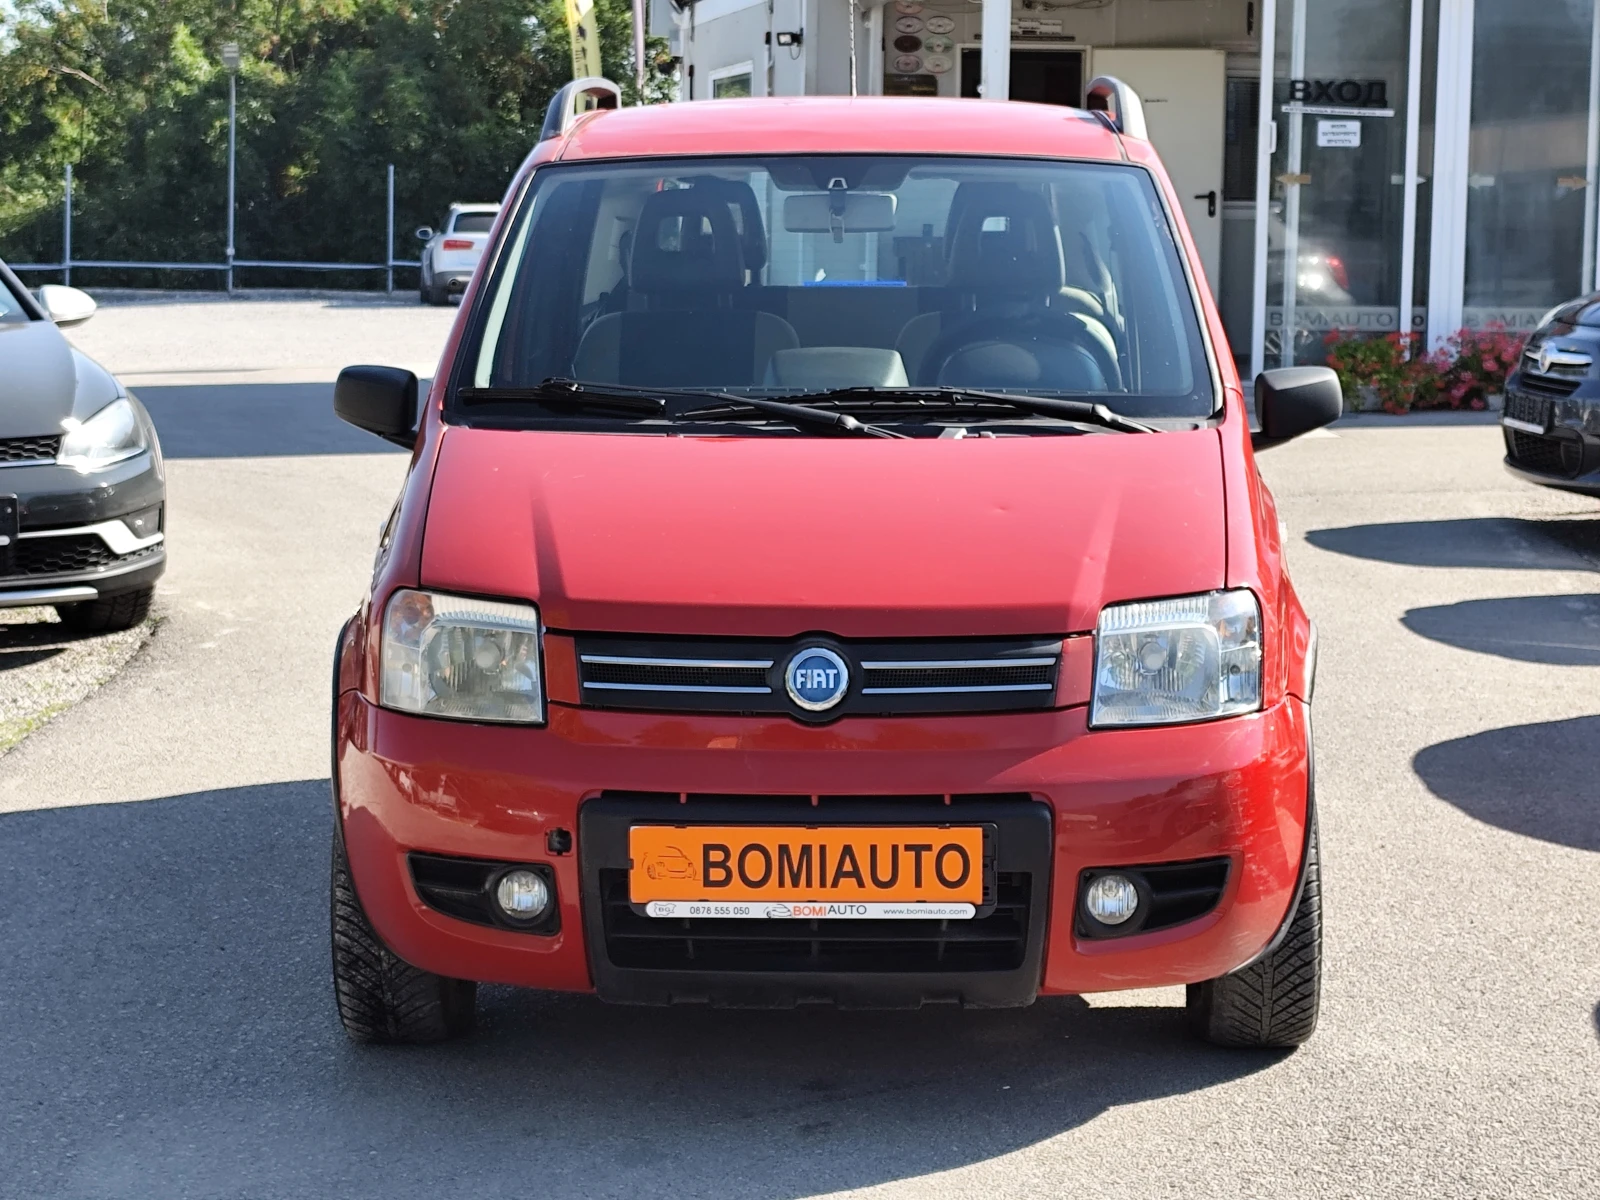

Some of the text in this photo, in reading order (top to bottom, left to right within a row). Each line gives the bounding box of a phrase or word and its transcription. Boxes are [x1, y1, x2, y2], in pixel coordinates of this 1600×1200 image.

[1289, 80, 1388, 108] ВХОД
[796, 669, 838, 689] FIAT
[702, 843, 971, 889] BOMIAUTO
[690, 906, 712, 915] 0878
[714, 906, 731, 915] 555
[733, 906, 750, 915] 050
[793, 904, 867, 917] BOMIAUTO
[883, 907, 968, 916] www.bomiauto.com
